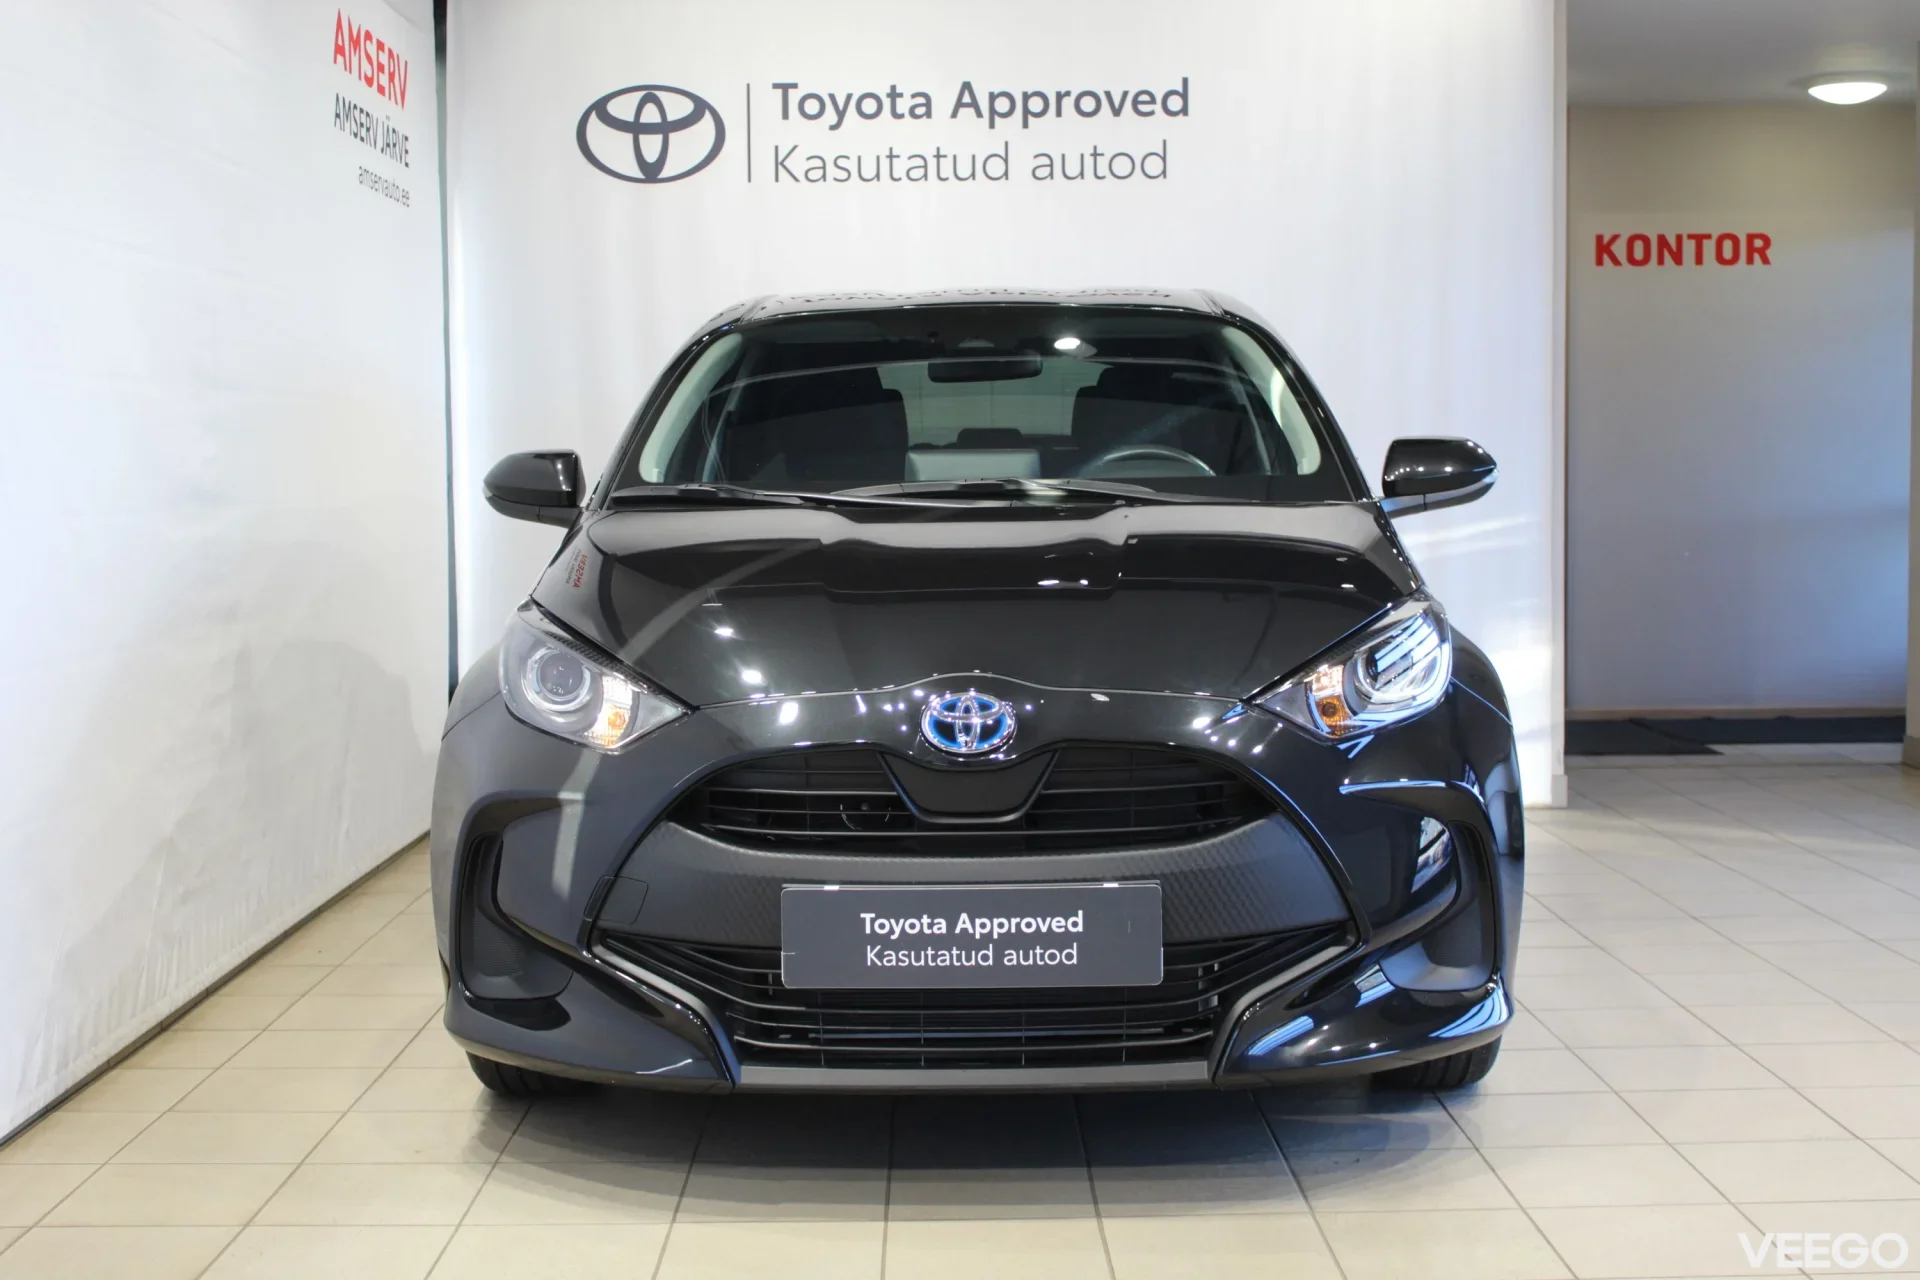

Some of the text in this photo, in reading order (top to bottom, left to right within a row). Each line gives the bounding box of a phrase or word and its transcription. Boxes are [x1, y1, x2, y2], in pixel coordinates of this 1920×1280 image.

[333, 8, 408, 111] AMSERV
[772, 77, 1190, 131] Toyota Approved
[334, 93, 409, 168] AMSERV JÄRVE
[774, 139, 1168, 183] Kasutatud autod
[358, 165, 410, 208] amservauto.ee
[1594, 232, 1772, 267] KONTOR
[860, 910, 1084, 939] Toyota Approved
[866, 943, 1078, 966] Kasutatud autod
